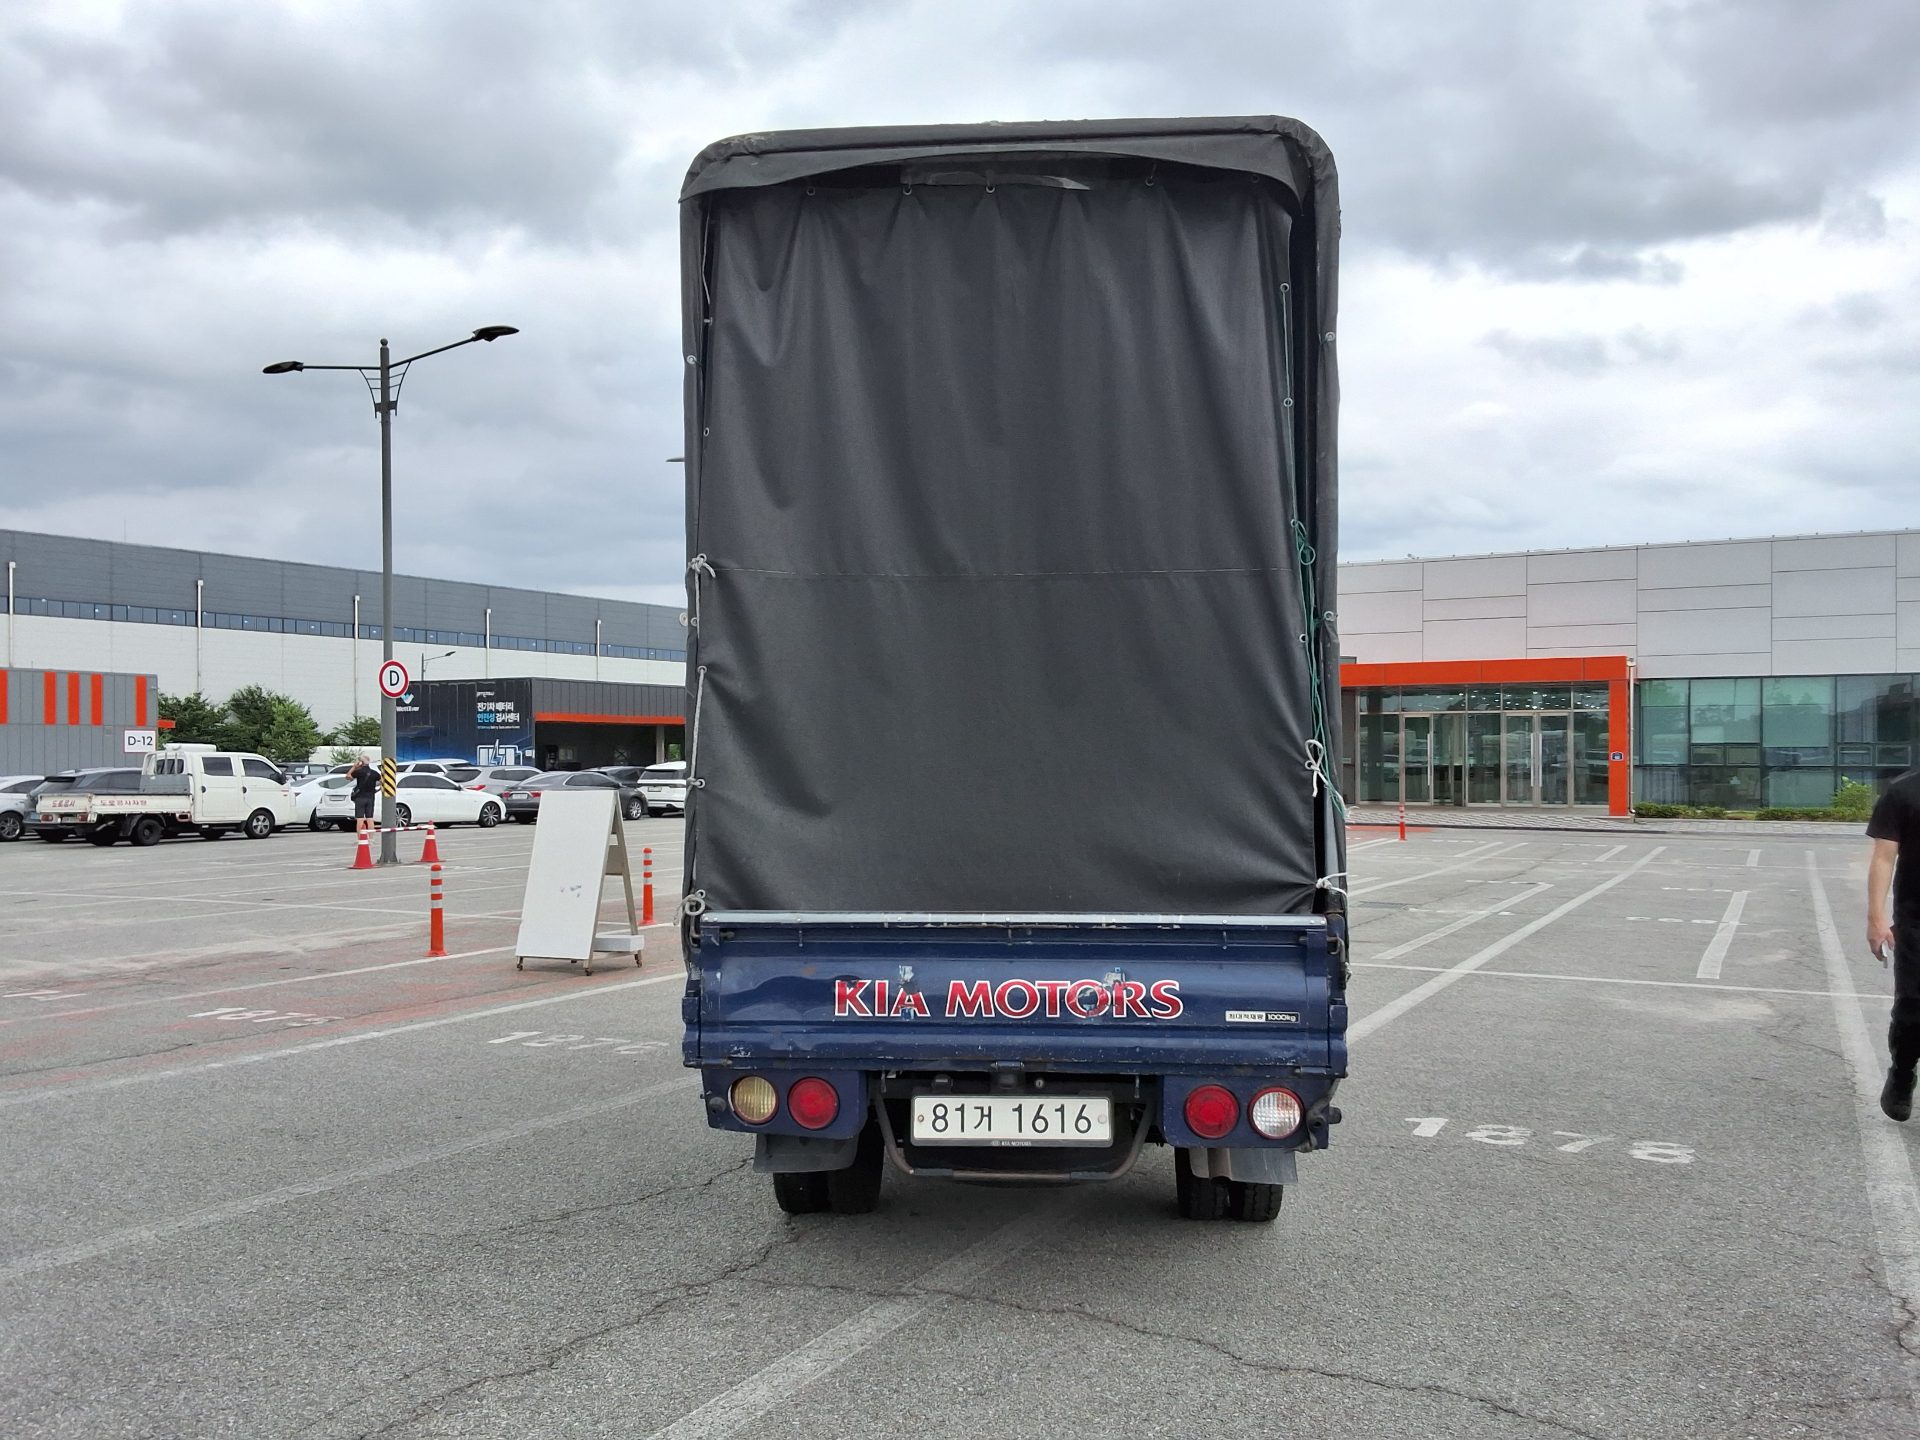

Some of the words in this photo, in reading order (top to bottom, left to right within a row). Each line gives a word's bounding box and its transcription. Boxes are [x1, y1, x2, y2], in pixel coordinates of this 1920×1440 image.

[389, 670, 400, 687] D
[477, 702, 495, 712] 전기차
[496, 702, 514, 712] 배터리
[496, 712, 520, 723] 검사센터
[127, 735, 153, 746] D-12
[834, 979, 932, 1018] KIA
[944, 979, 1185, 1020] MOTORS
[1267, 1013, 1297, 1022] 1000kg
[931, 1102, 992, 1133] 81거
[1011, 1102, 1092, 1134] 1616
